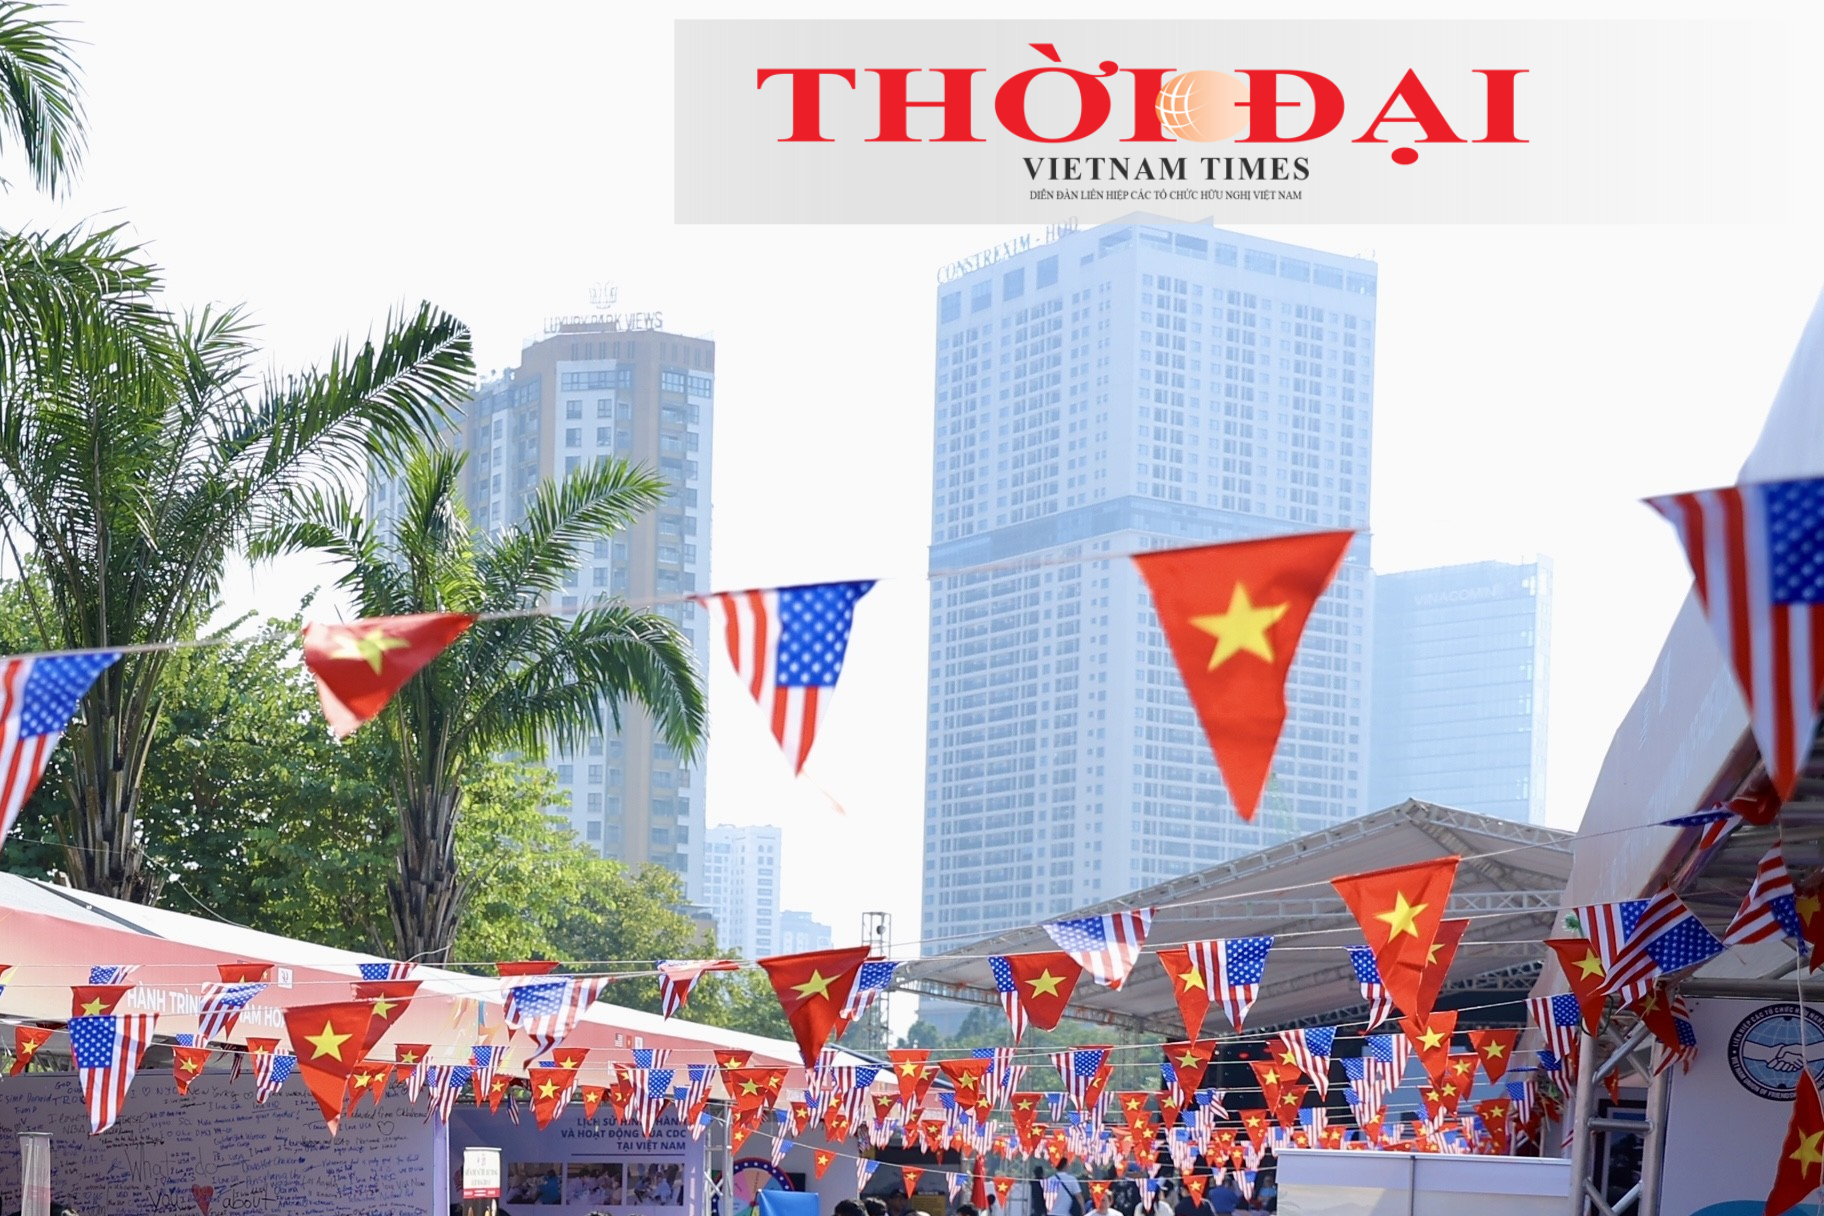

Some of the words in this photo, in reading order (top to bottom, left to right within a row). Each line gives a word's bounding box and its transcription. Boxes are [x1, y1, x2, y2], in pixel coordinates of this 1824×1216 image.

[625, 311, 663, 331] VIEWS
[127, 982, 165, 1012] HÀNH
[561, 1128, 575, 1138] VÀ
[577, 1130, 606, 1140] HOẠT
[608, 1128, 639, 1141] ĐỘNG
[666, 1130, 686, 1138] CDC
[617, 1142, 633, 1152] TẠI
[636, 1140, 658, 1152] VIỆT
[660, 1142, 686, 1151] NAM
